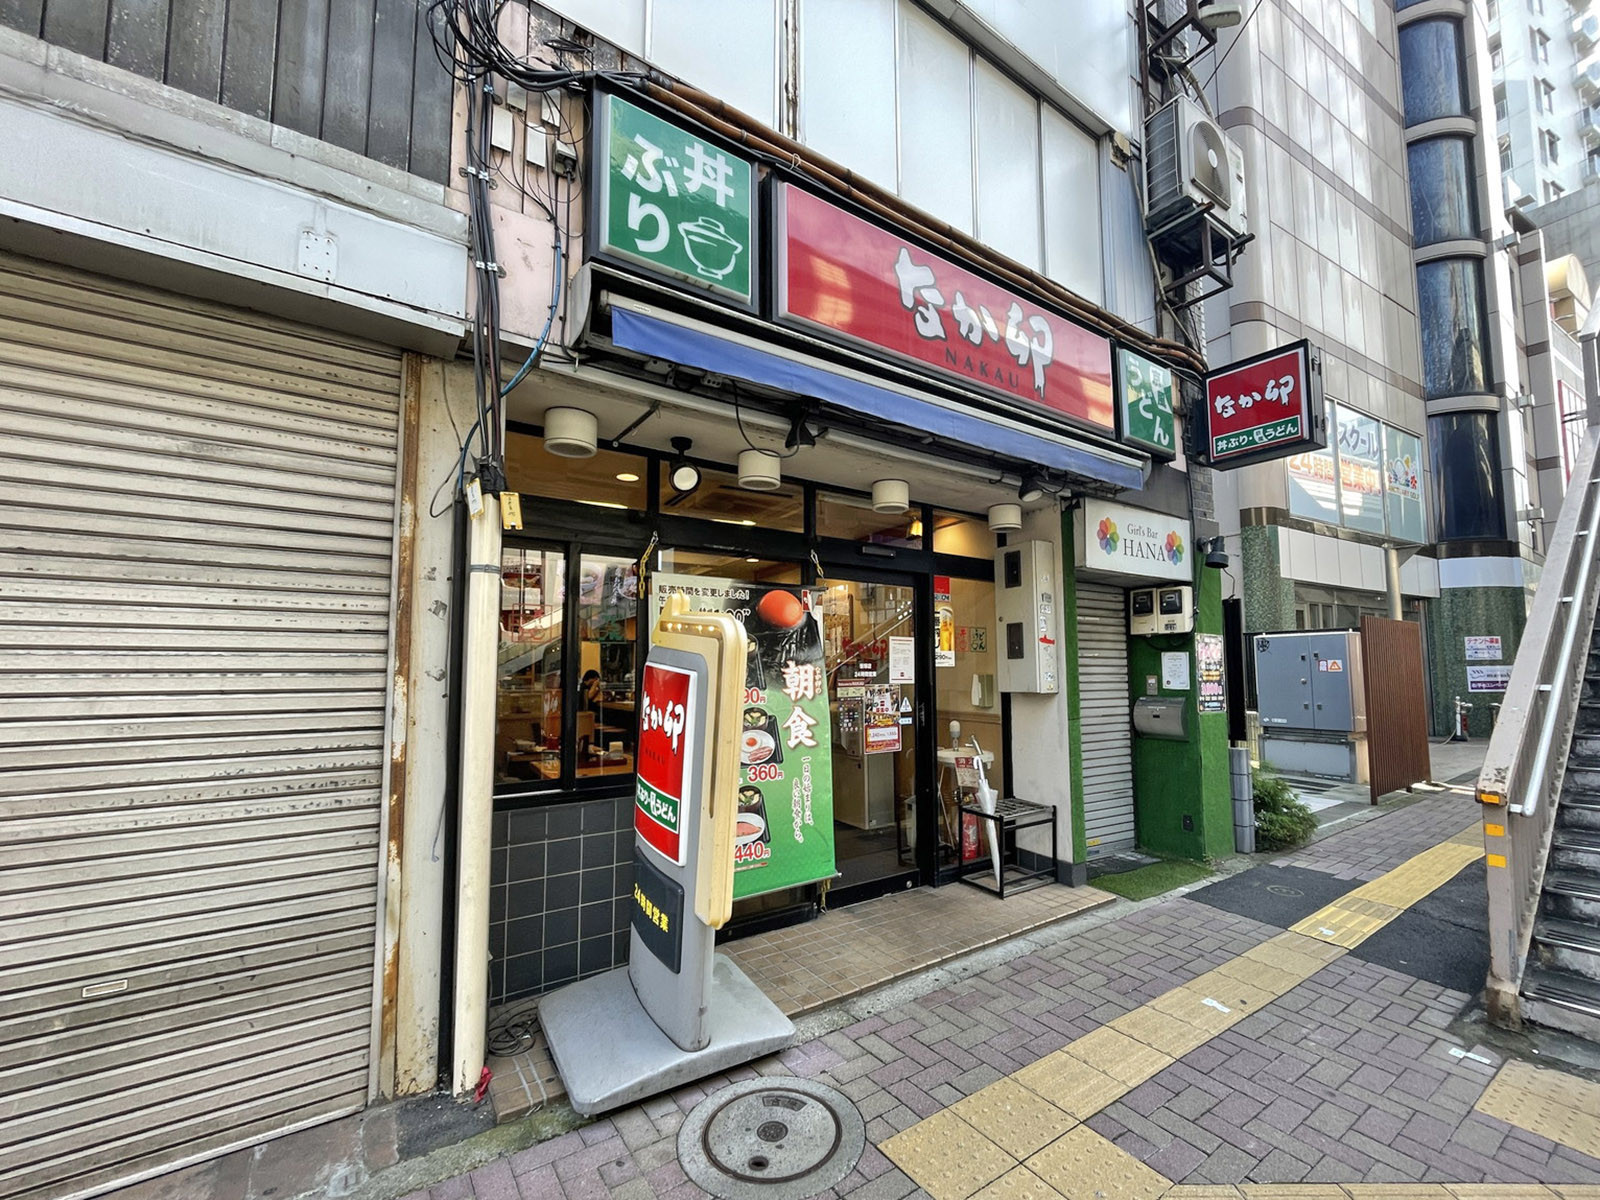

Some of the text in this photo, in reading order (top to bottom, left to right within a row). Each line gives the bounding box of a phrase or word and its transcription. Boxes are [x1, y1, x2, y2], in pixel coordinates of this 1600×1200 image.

[894, 246, 1055, 399] なか卯
[945, 346, 1019, 388] NAKAU
[1214, 374, 1295, 419] なか卯
[1122, 538, 1167, 562] HANA
[1147, 527, 1159, 539] Bar
[642, 690, 685, 756] なか卯
[781, 660, 818, 749] 朝食
[748, 763, 784, 783] 360円
[634, 882, 669, 933] 24時間営業
